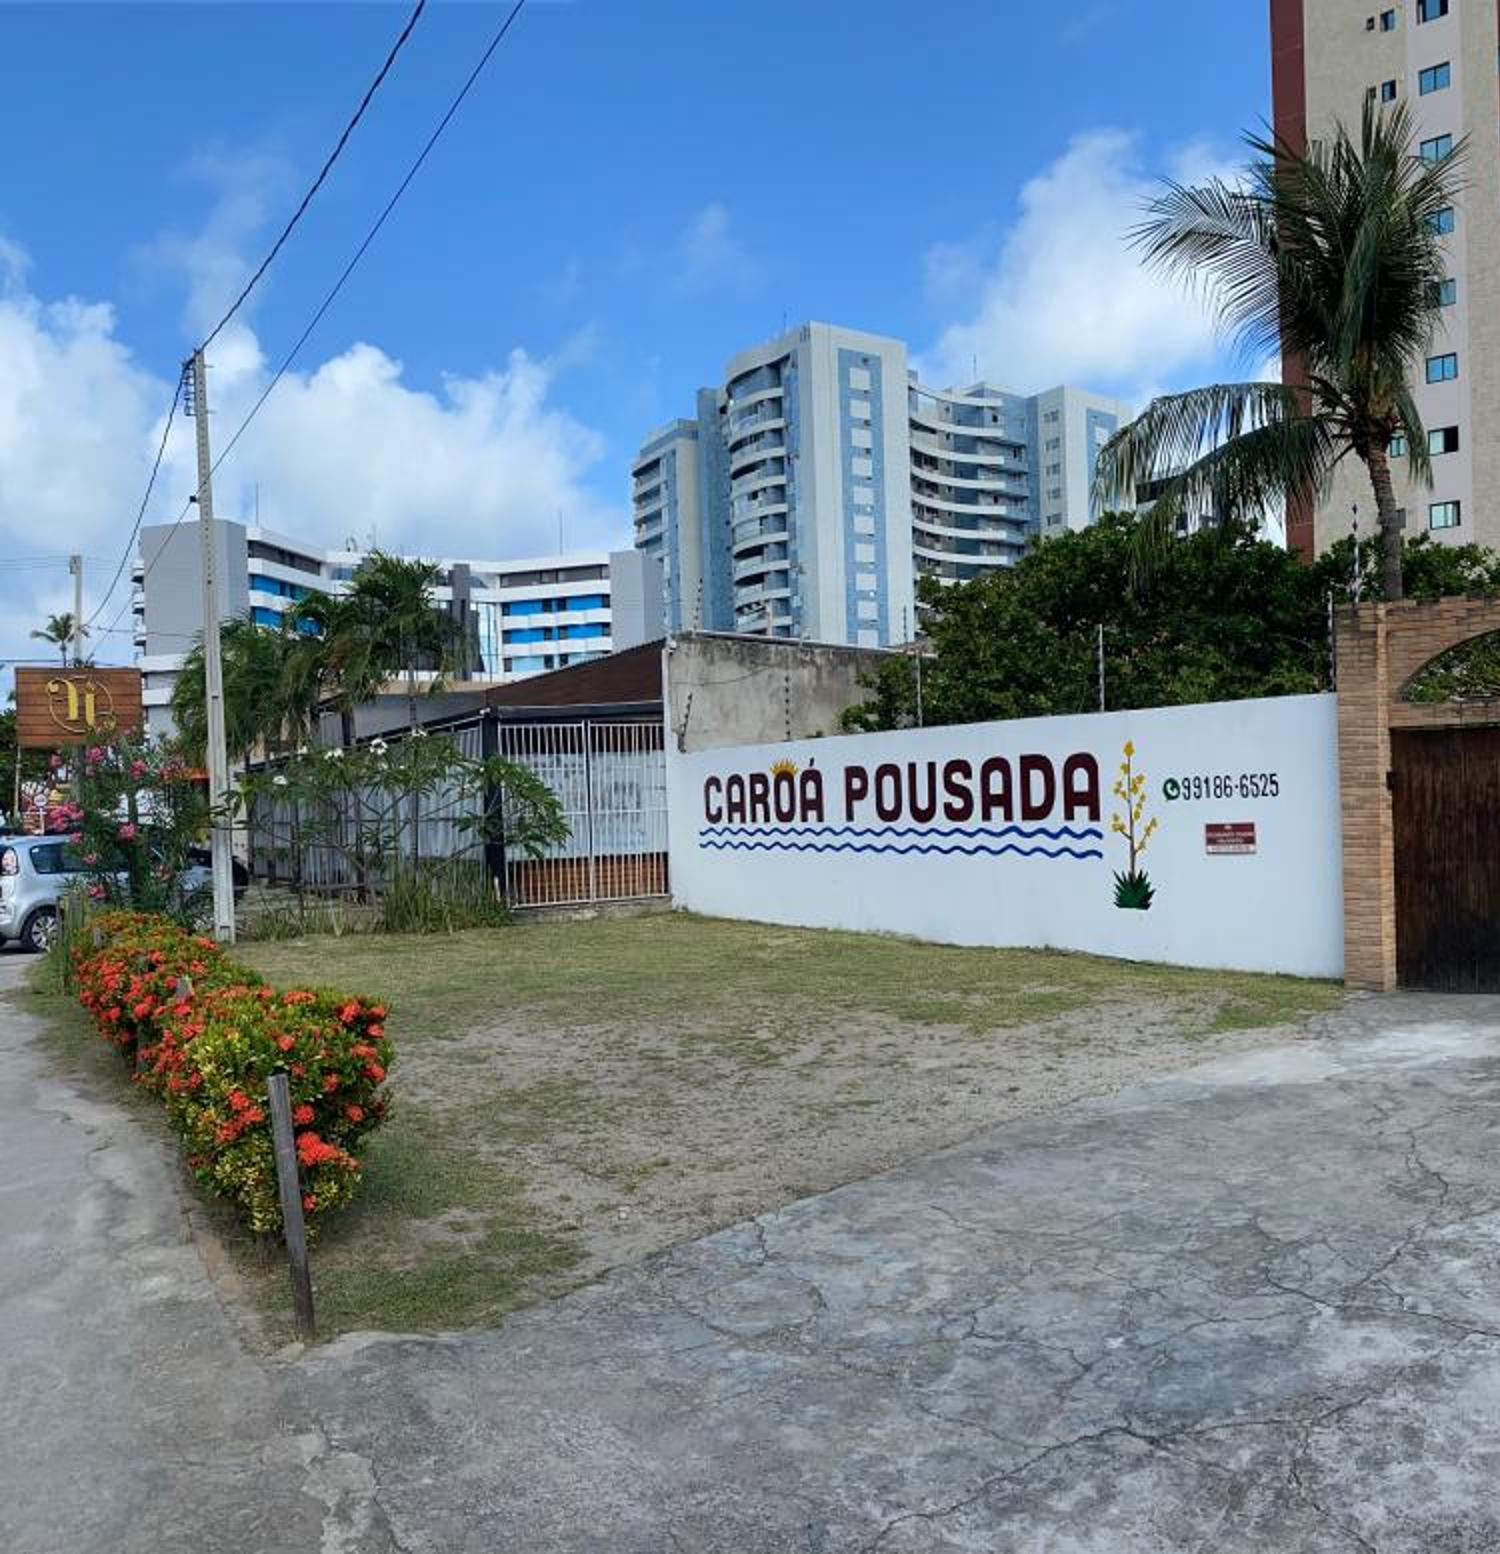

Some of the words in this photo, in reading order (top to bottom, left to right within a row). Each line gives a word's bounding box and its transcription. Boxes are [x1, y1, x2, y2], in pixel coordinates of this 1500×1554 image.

[704, 757, 824, 825] CAROÁ
[844, 752, 1101, 824] POUSADA
[1181, 773, 1279, 801] 99186-6525
